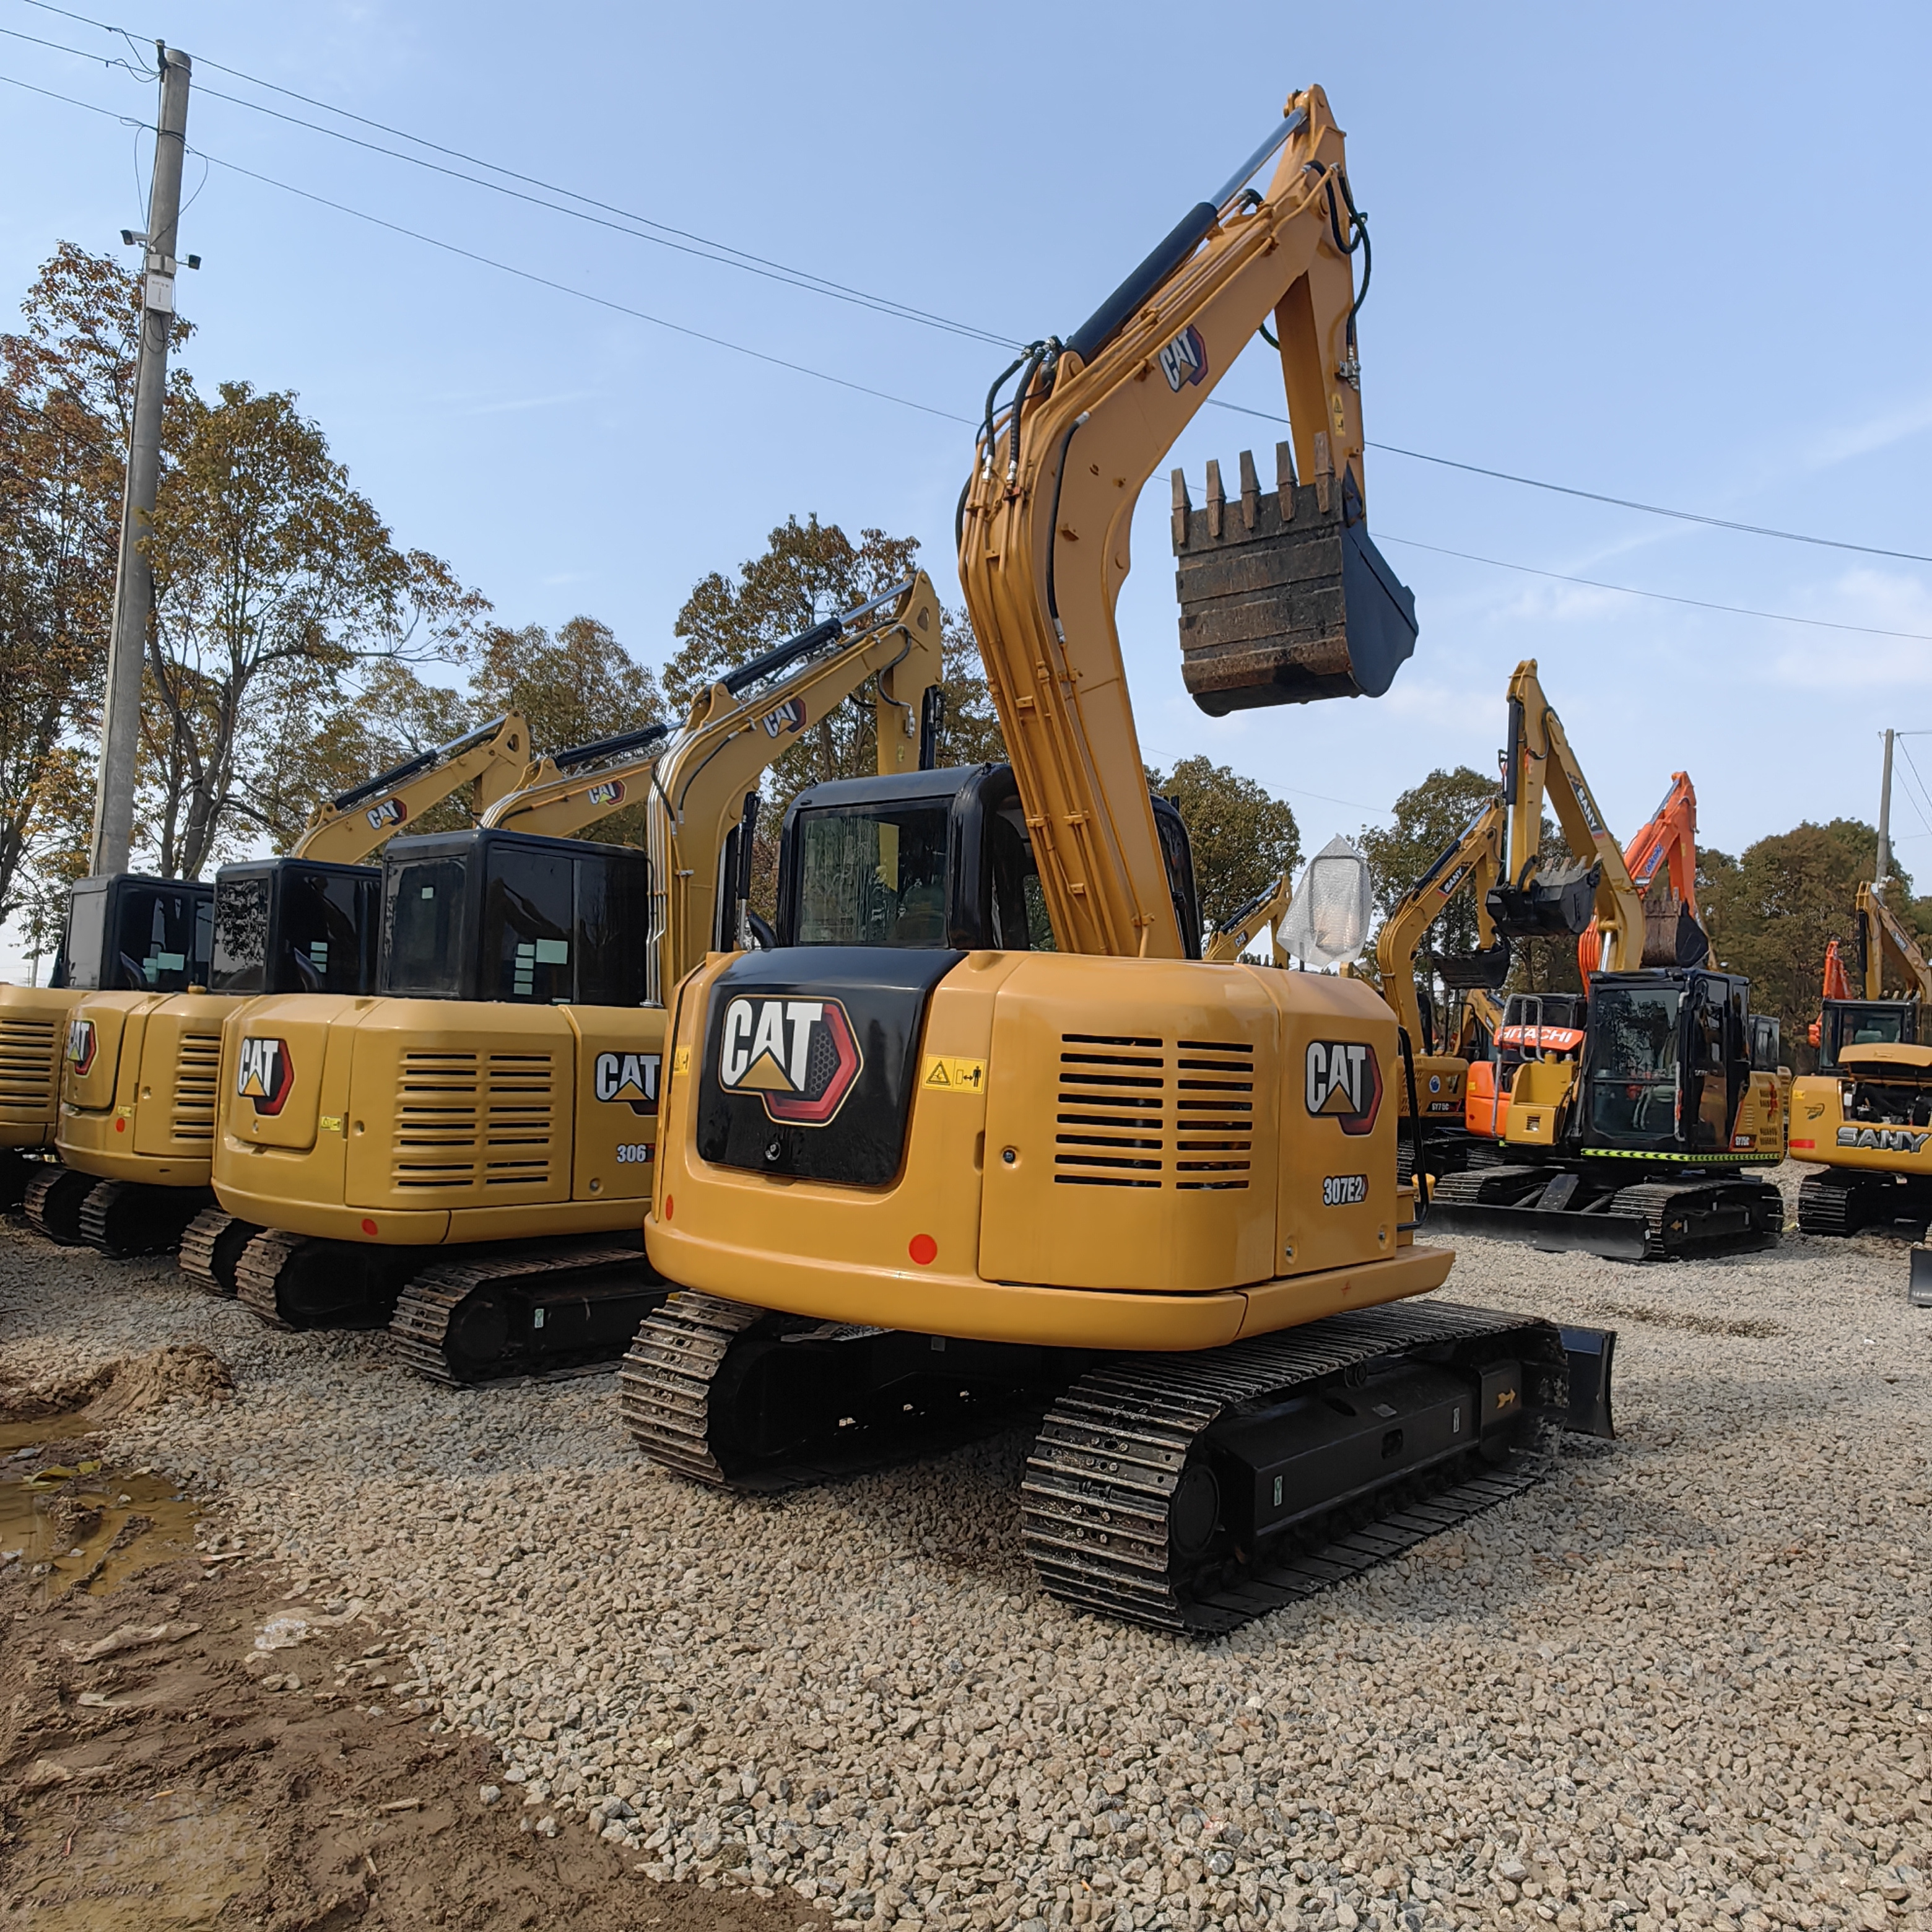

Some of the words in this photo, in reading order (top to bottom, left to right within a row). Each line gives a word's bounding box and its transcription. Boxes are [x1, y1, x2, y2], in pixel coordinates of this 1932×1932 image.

[1159, 327, 1199, 391] CAT
[762, 702, 798, 738] CAT
[367, 799, 399, 829] CAT
[1577, 787, 1597, 828] SANY
[1444, 866, 1462, 892] SANY
[1235, 931, 1247, 947] CAT
[722, 999, 823, 1091] CAT
[1498, 1027, 1573, 1043] HITACHI
[238, 1038, 279, 1097] CAT
[596, 1053, 661, 1100] CAT
[1307, 1042, 1365, 1113] CAT
[617, 1144, 646, 1162] 306
[1837, 1126, 1931, 1152] SANY
[1324, 1177, 1362, 1204] 307E2
